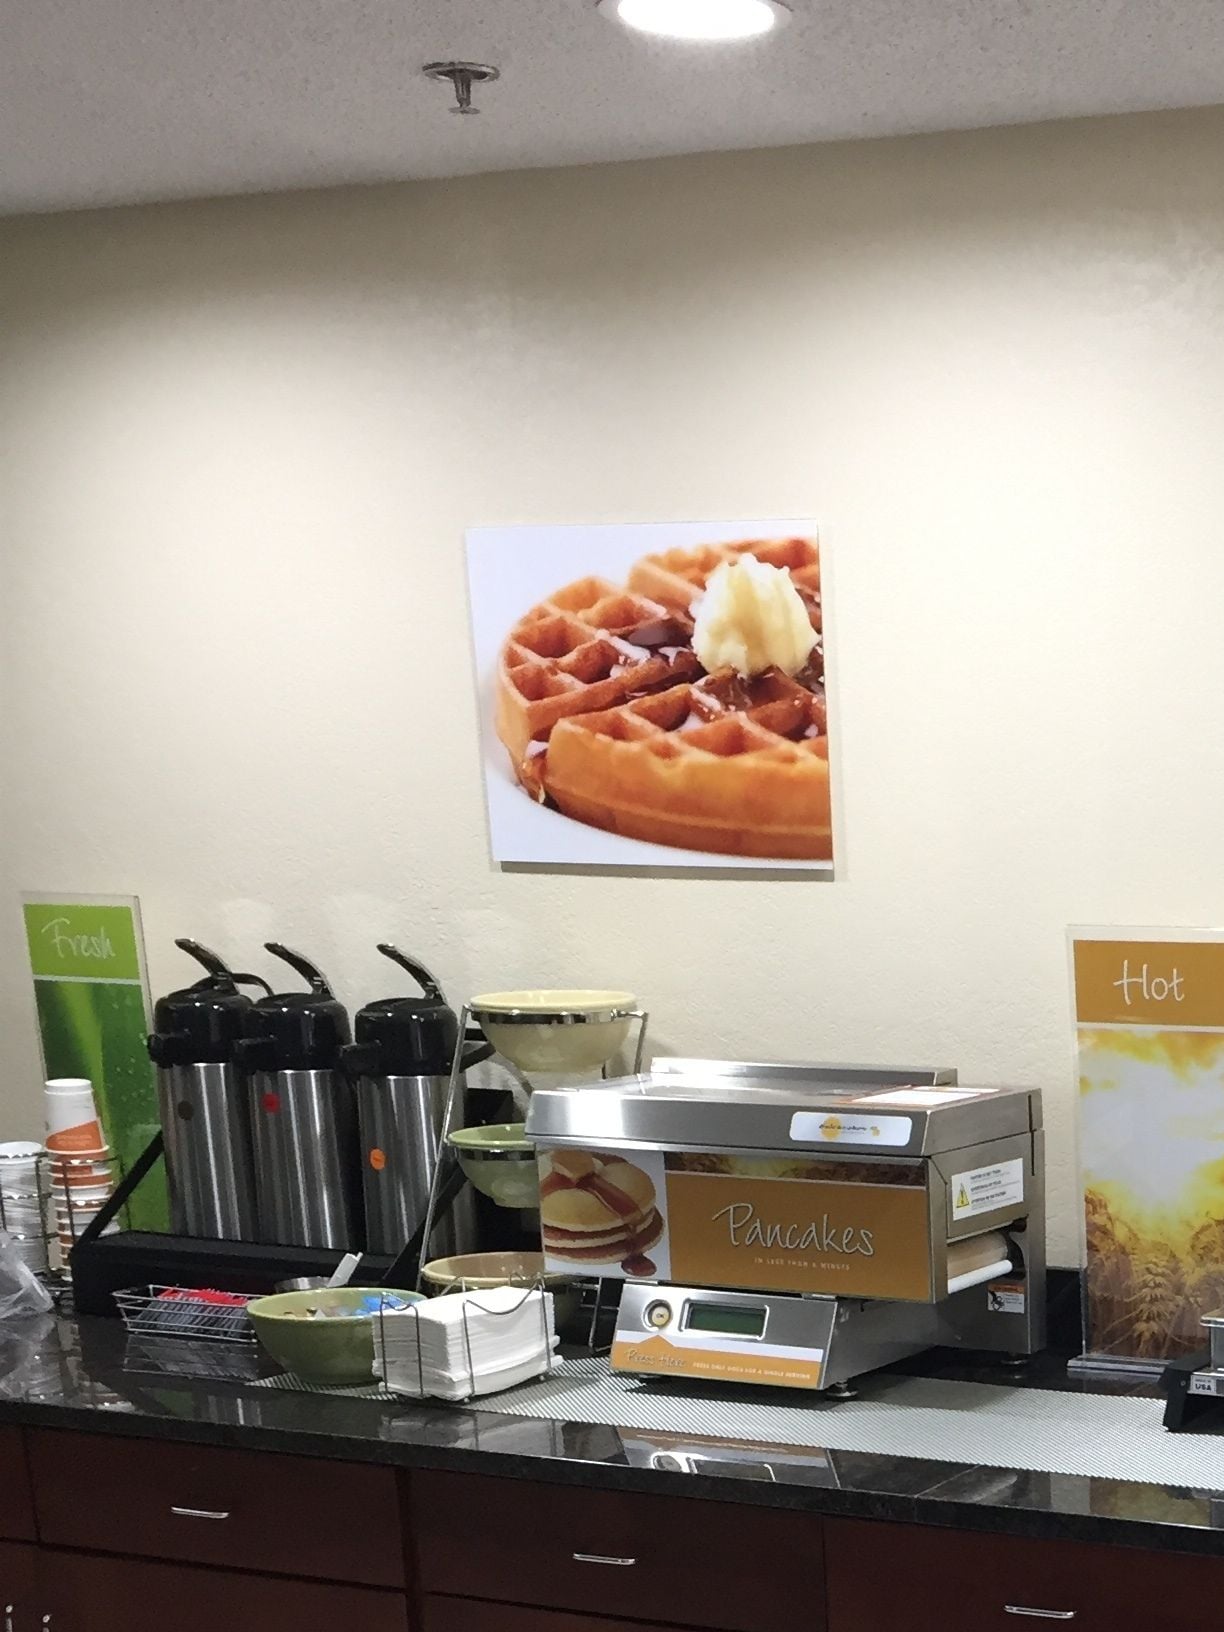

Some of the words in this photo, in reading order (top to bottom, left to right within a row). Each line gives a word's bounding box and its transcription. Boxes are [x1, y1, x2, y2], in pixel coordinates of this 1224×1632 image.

[41, 917, 116, 960] Fresh
[1113, 959, 1185, 1006] Hot
[711, 1203, 874, 1256] Pancakes
[1195, 1383, 1212, 1391] USA
